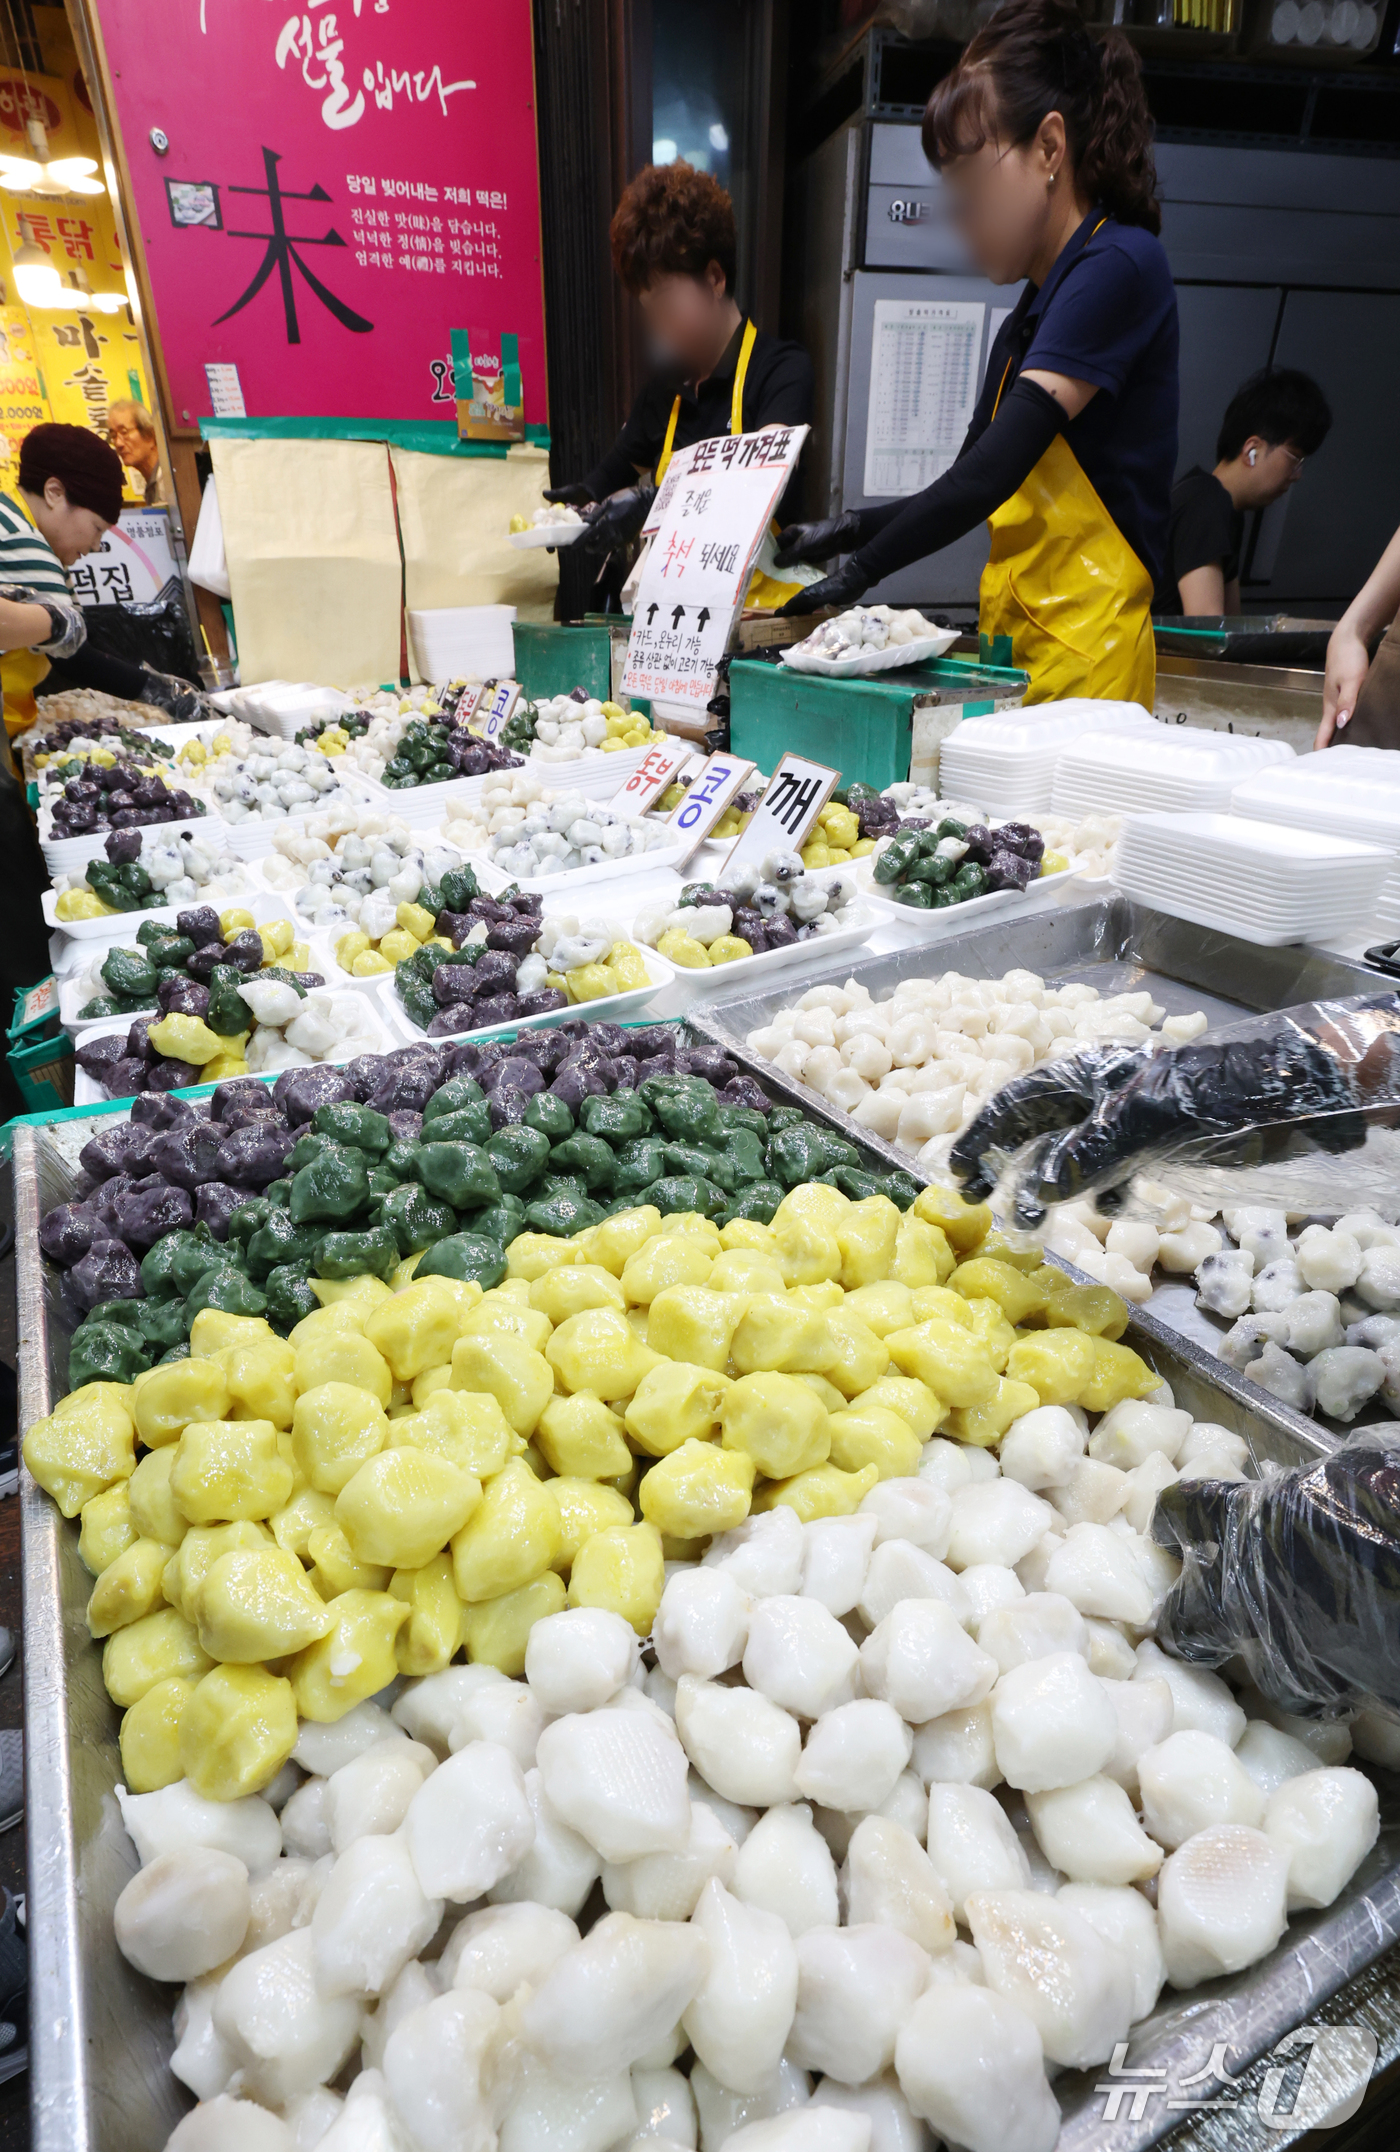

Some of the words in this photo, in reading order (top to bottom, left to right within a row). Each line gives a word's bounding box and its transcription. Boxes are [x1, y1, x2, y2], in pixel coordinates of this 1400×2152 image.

[346, 174, 377, 196] 당일
[381, 178, 438, 202] 빚어내는
[444, 186, 471, 206] 저희
[476, 190, 508, 210] 떡은!
[351, 207, 390, 227] 진실한
[448, 218, 501, 239] 담습니다.
[353, 229, 392, 248] 넉넉한
[450, 239, 502, 259] 빚습니다.
[355, 250, 394, 269] 엄격한
[452, 259, 503, 279] 지킵니다.
[686, 440, 720, 475] 모든
[720, 436, 743, 470] 떡
[738, 428, 796, 468] 가격표
[681, 488, 712, 517] 즐거운
[699, 542, 740, 574] 되세요
[685, 636, 701, 656] 가능
[632, 650, 645, 670] 종류
[646, 652, 662, 670] 상관
[677, 657, 699, 673] 고르기
[700, 657, 715, 679] 가능
[626, 671, 638, 689] 모든
[639, 673, 652, 691] 떡은
[654, 677, 668, 694] 당일
[669, 679, 688, 695] 아침에
[487, 689, 510, 735] 콩
[625, 752, 674, 797] 동부
[677, 766, 732, 829] 콩
[765, 772, 824, 835] 깨
